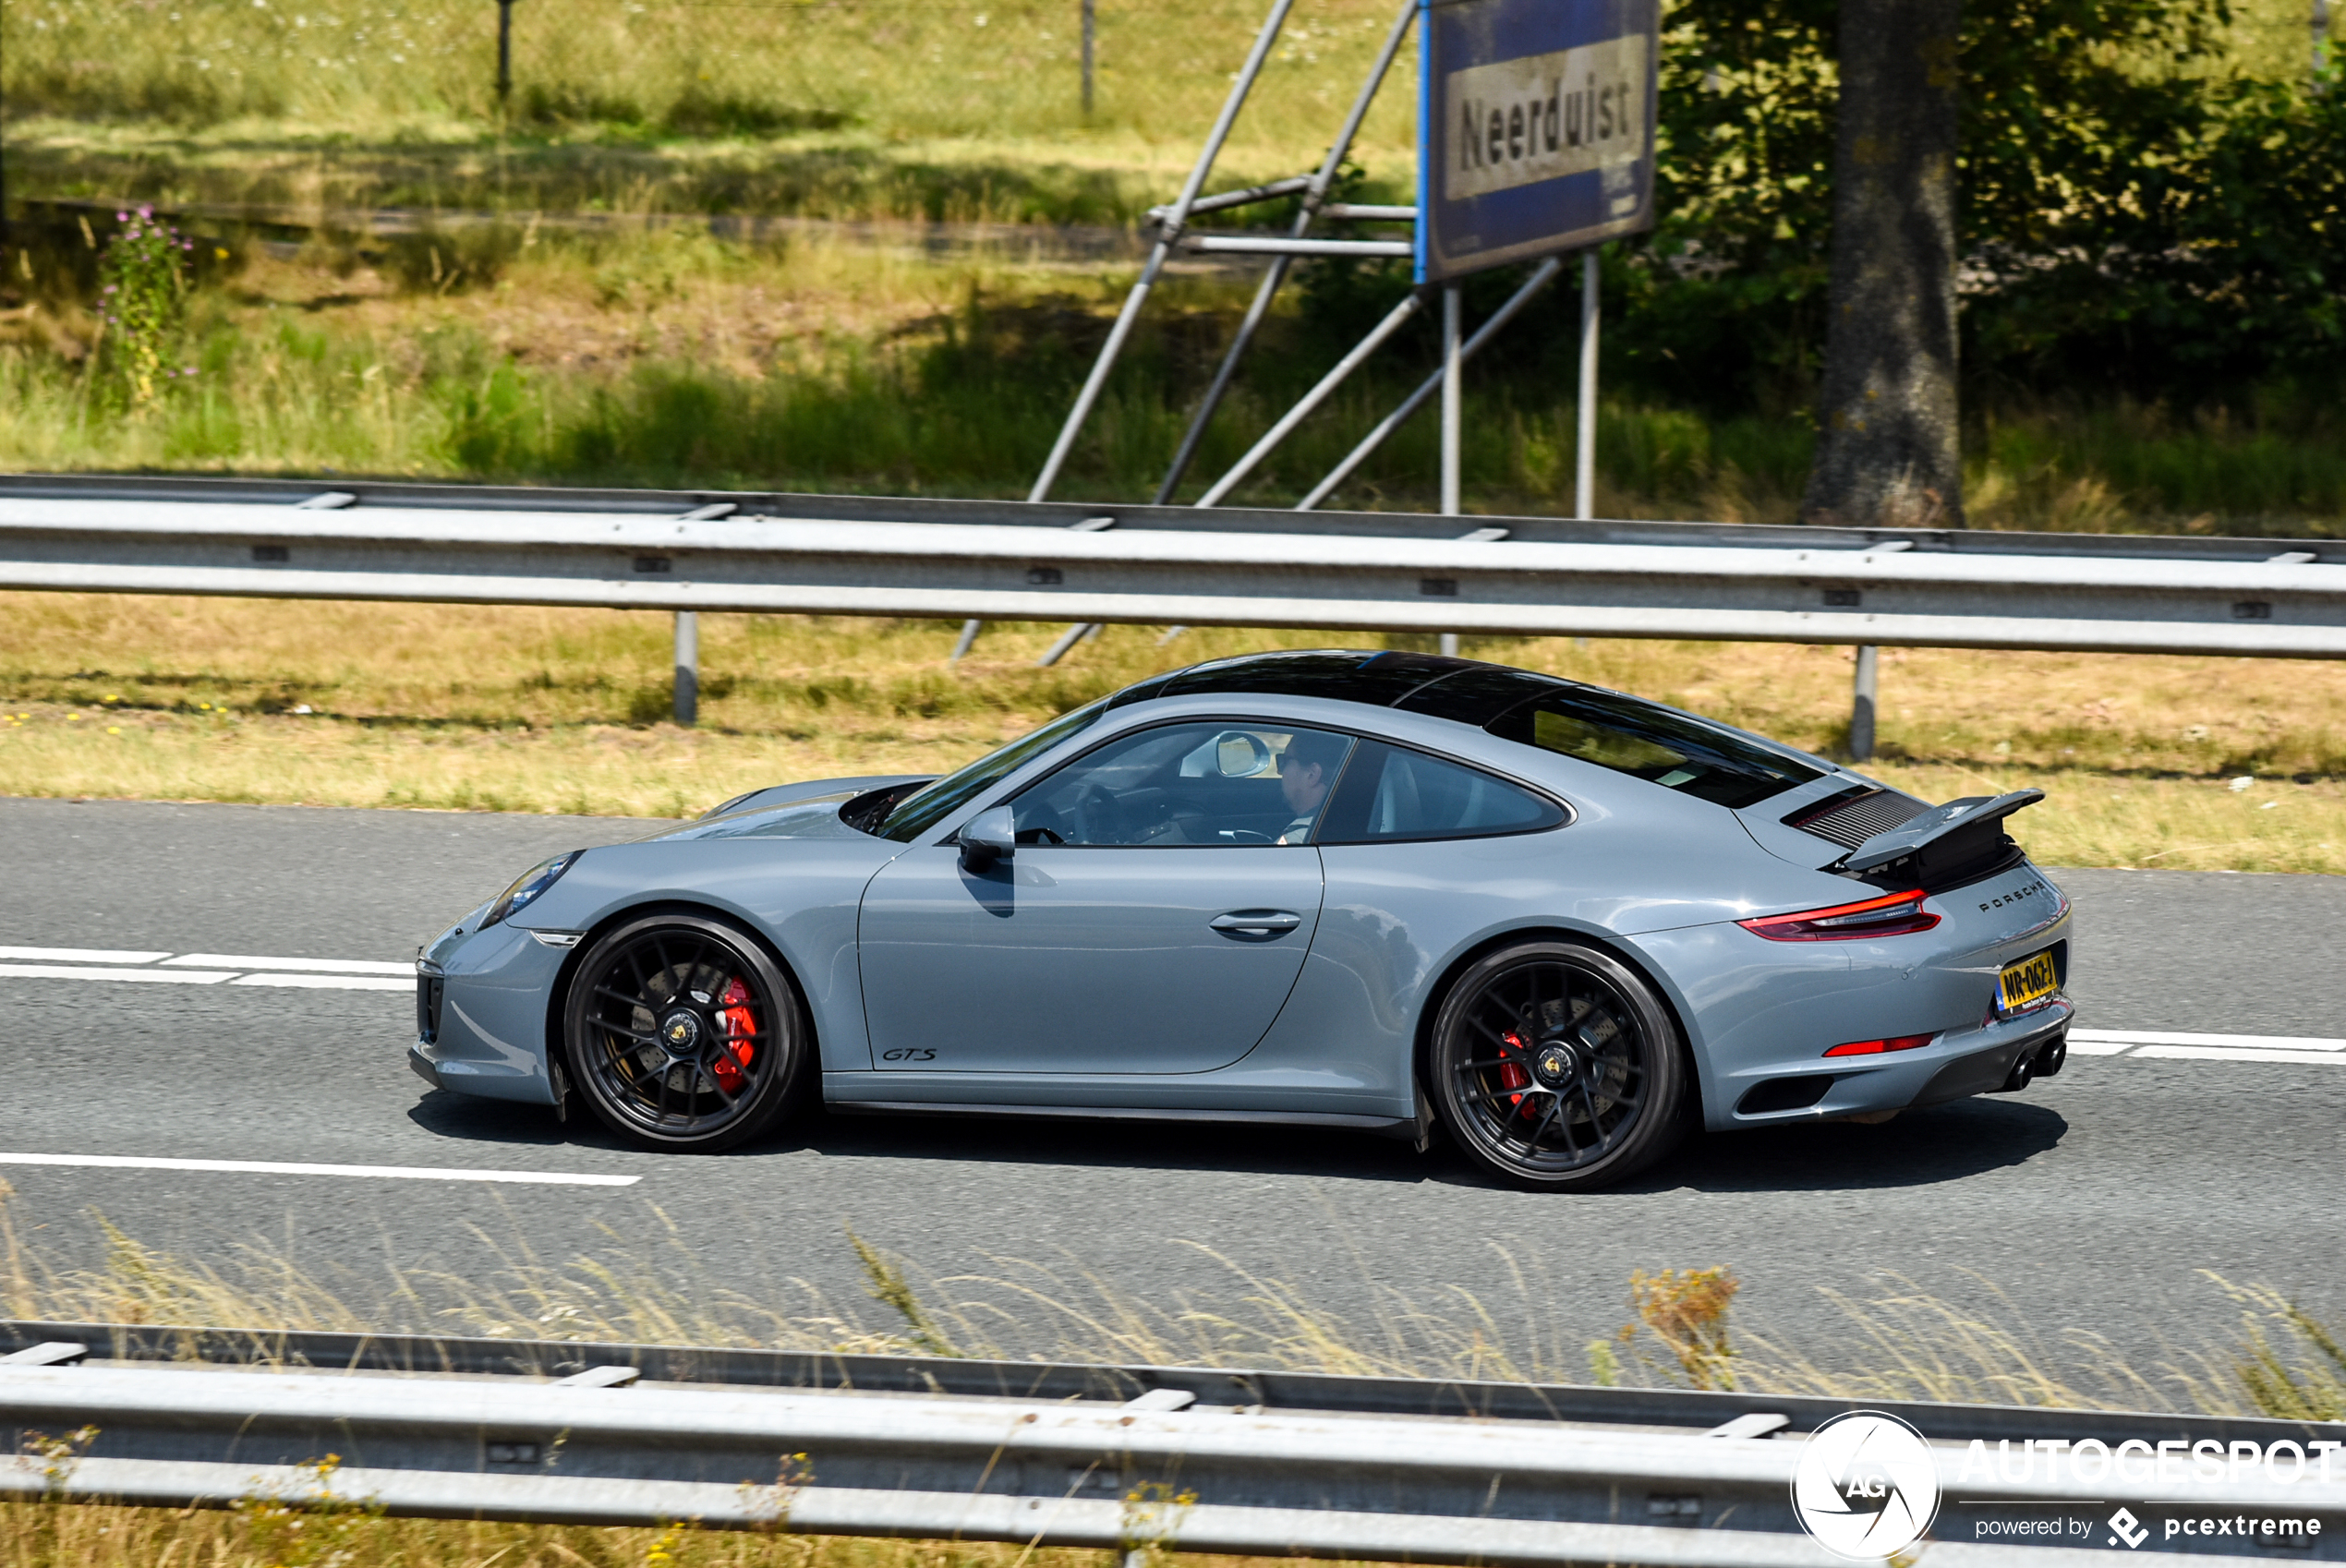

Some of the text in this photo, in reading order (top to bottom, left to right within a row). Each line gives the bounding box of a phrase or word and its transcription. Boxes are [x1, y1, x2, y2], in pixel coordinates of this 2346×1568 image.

[1459, 72, 1630, 171] Neerduist
[1978, 880, 2046, 913] PORSCHE
[2003, 956, 2054, 1003] NR-062-J
[882, 1048, 937, 1062] GTS
